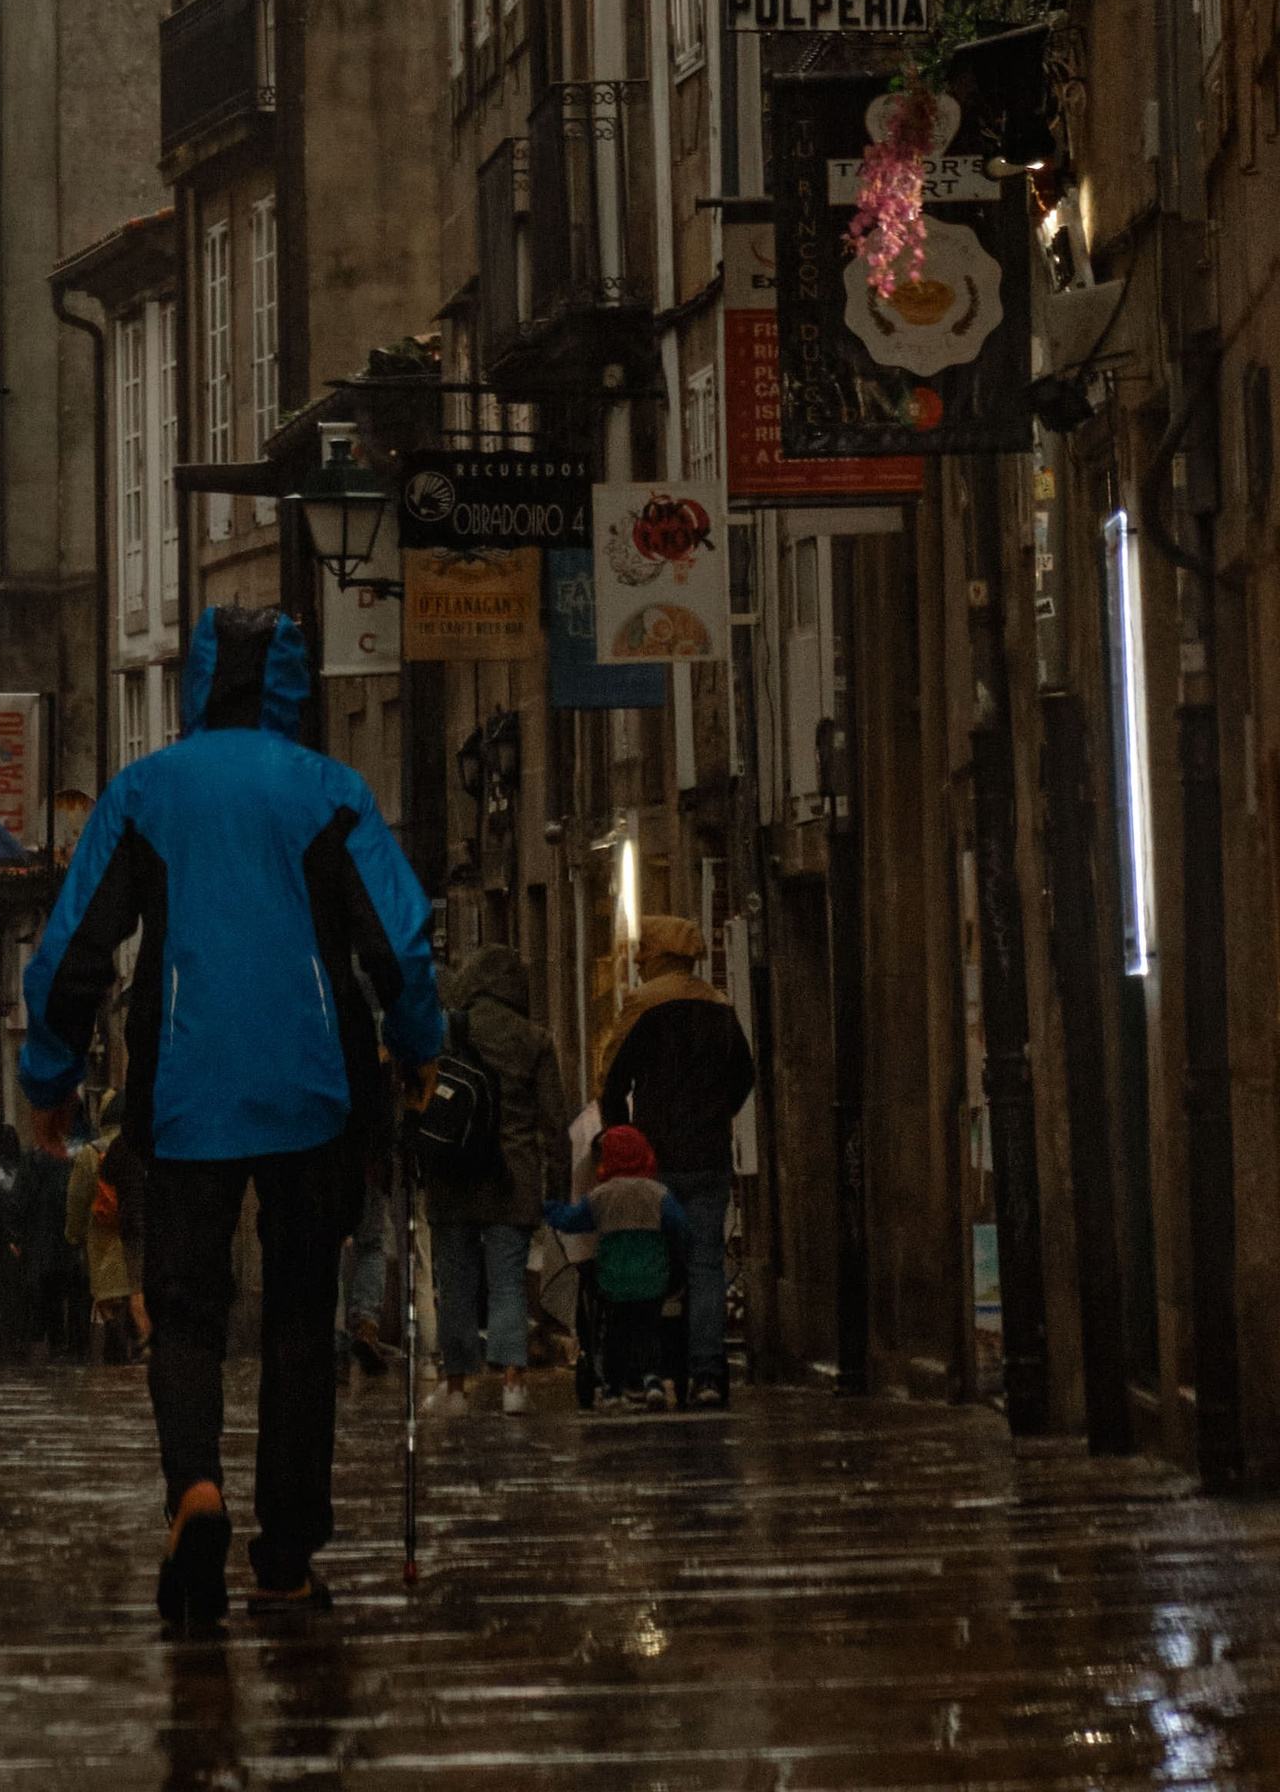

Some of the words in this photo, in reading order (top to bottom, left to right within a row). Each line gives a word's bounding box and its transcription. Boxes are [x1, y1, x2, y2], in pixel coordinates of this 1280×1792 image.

[455, 462, 586, 478] RECUERDOS
[453, 503, 564, 537] OBRADOIRO
[571, 504, 586, 532] 4
